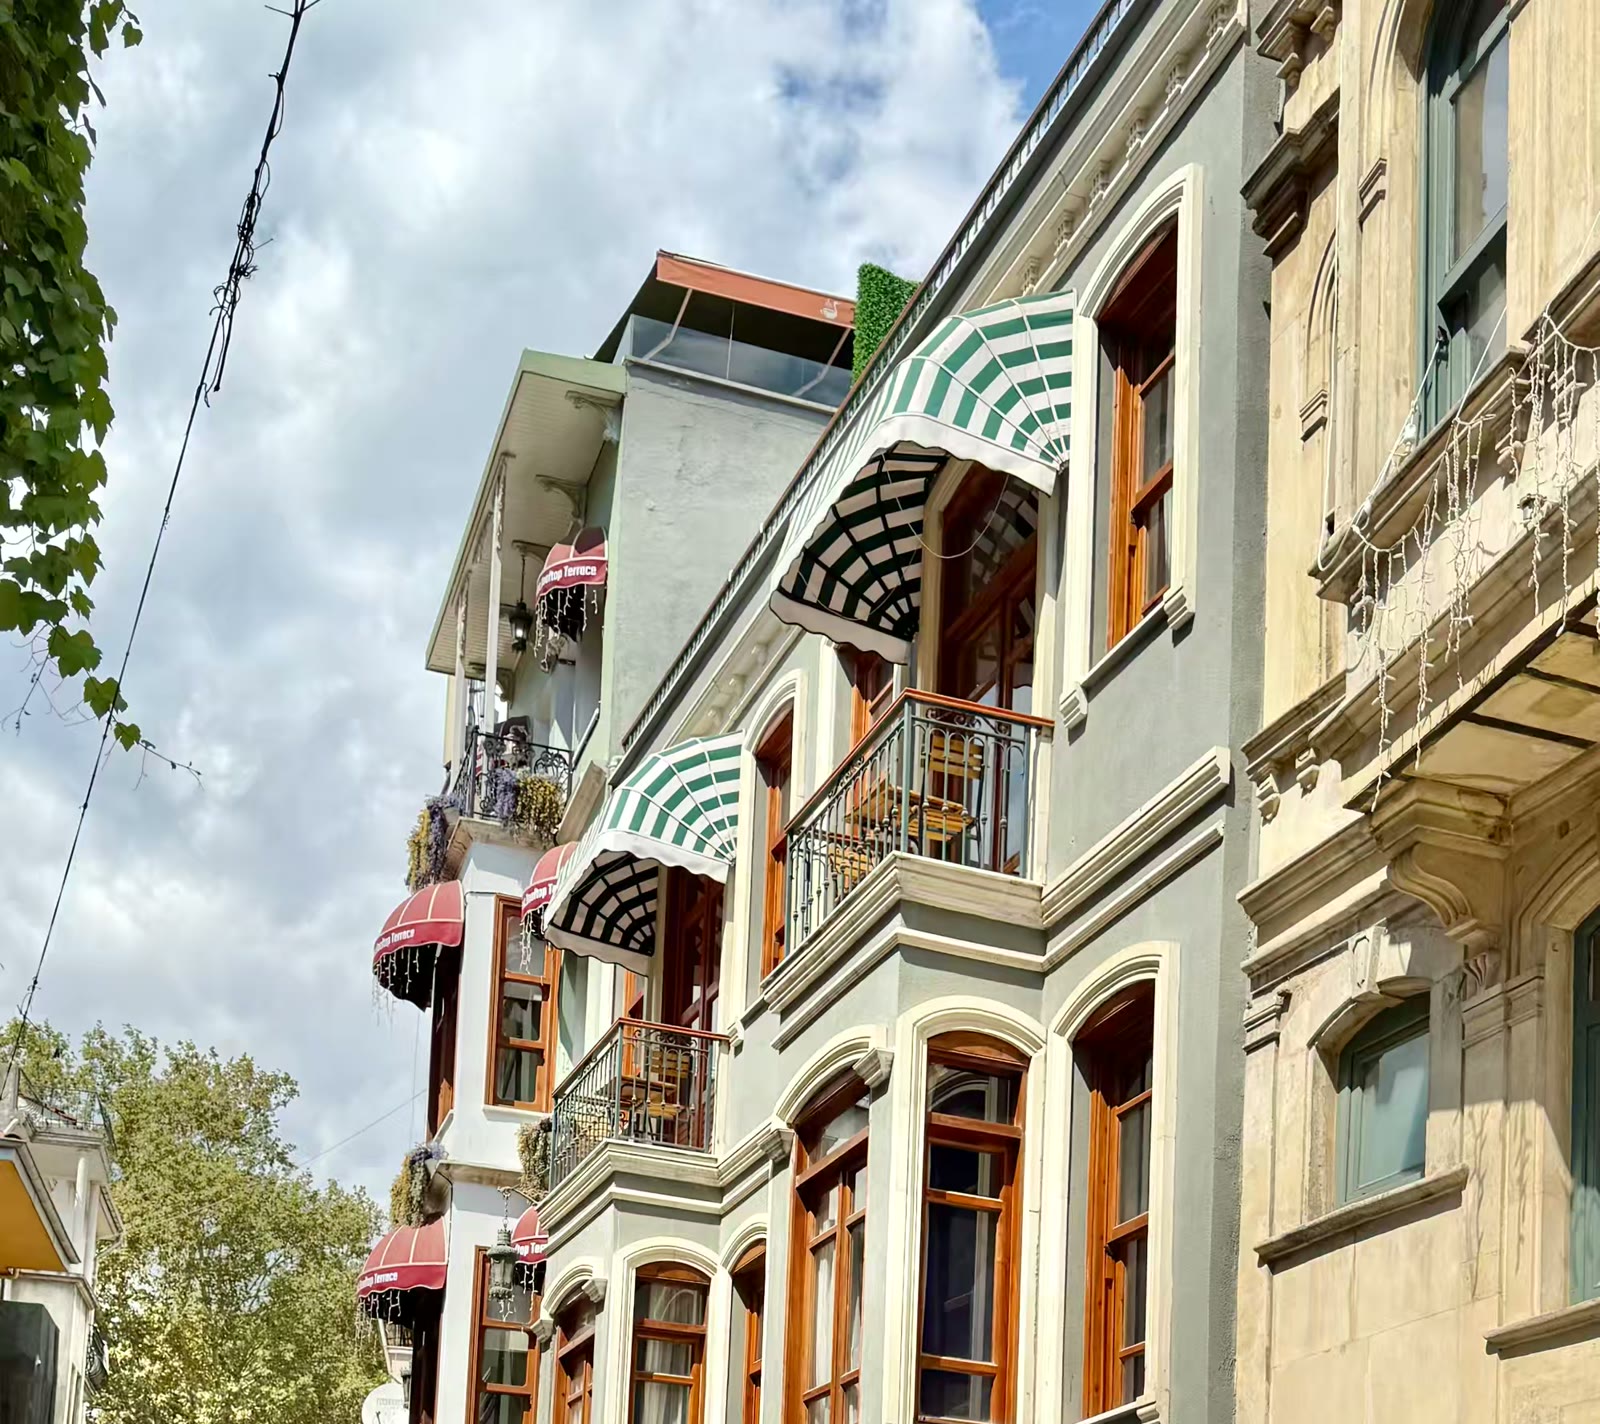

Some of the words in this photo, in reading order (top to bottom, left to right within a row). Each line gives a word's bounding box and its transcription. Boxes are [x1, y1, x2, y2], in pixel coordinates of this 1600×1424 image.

[563, 565, 597, 578] Terrace
[391, 928, 415, 944] Terrace
[374, 1271, 399, 1285] Terrace
